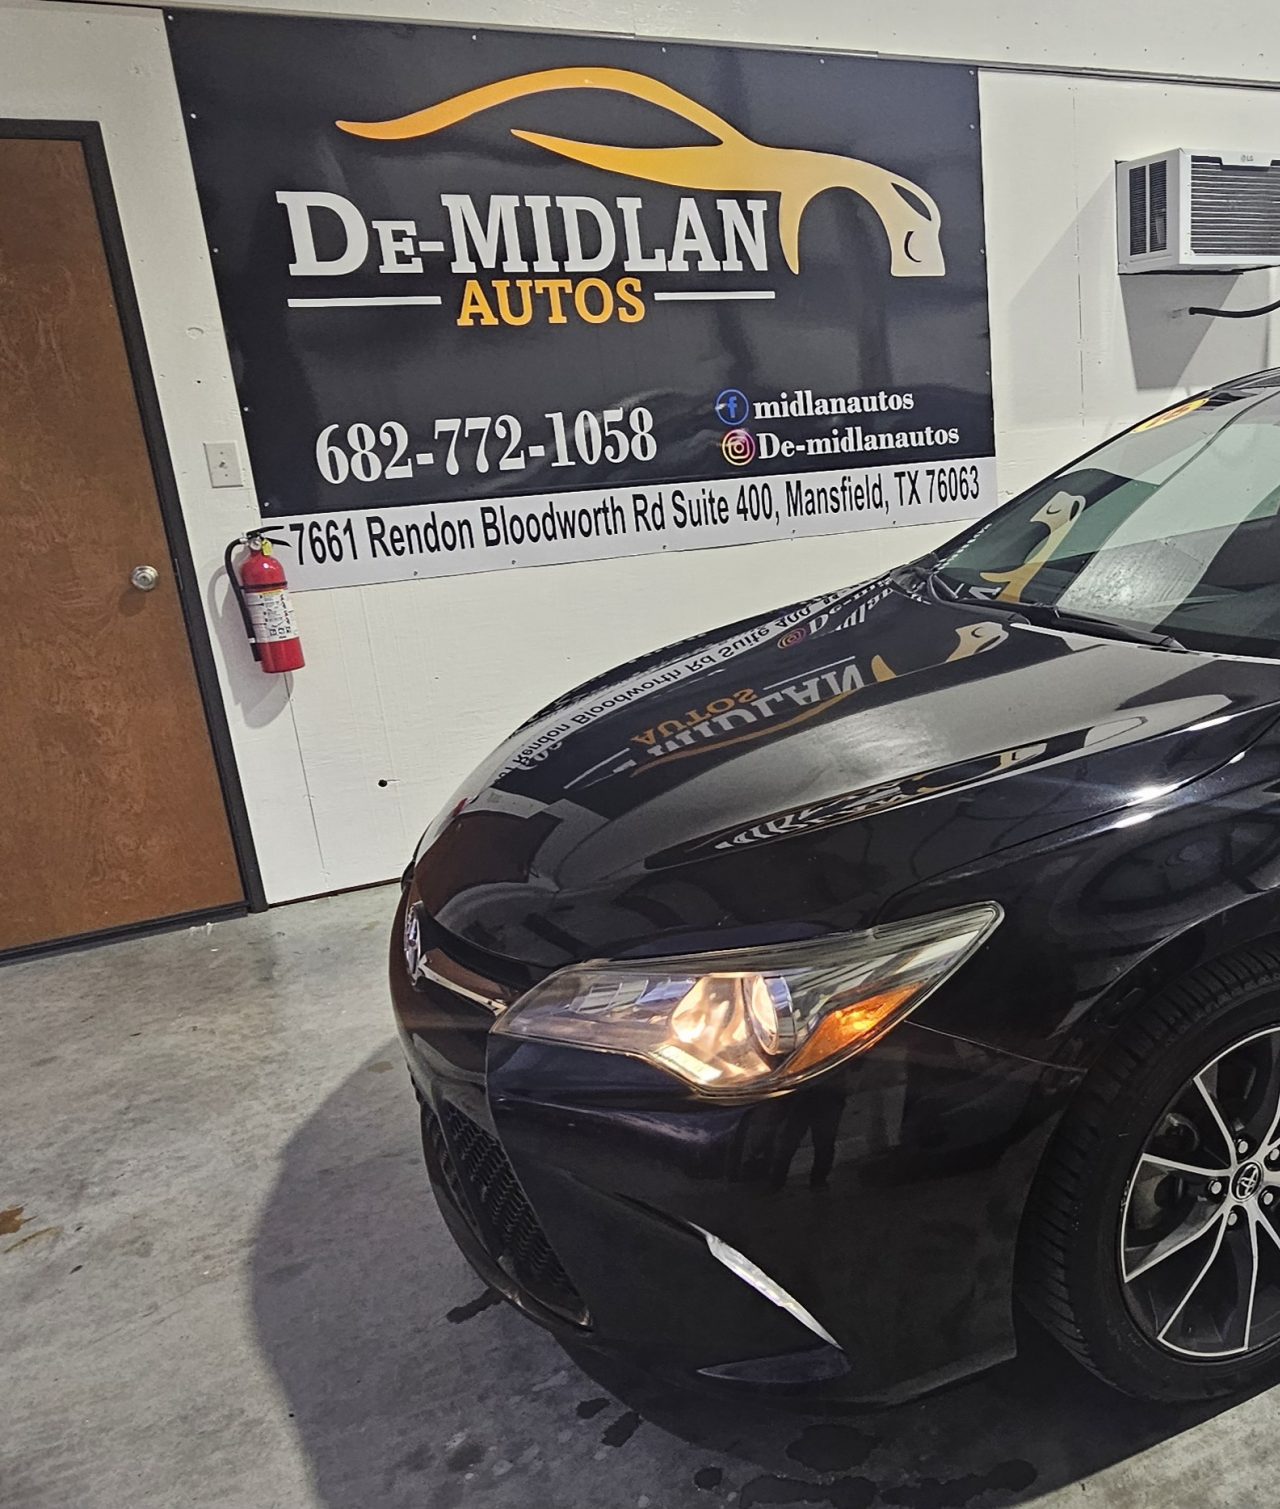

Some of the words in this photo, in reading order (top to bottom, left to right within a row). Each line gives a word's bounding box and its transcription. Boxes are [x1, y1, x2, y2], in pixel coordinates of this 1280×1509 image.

[456, 277, 646, 327] AUTOS
[752, 389, 915, 420] midlanautos
[315, 406, 658, 485] 682-772-1058
[756, 426, 960, 460] De-midlanautos
[288, 517, 358, 566] 7661
[365, 511, 476, 559] Rendon
[479, 496, 627, 548] Bloodworth
[631, 491, 667, 533] Rd
[671, 486, 730, 531] Suite
[735, 482, 781, 526] 400,
[784, 472, 890, 515] Mansfield,
[893, 469, 922, 507] TX
[925, 464, 981, 504] 76063
